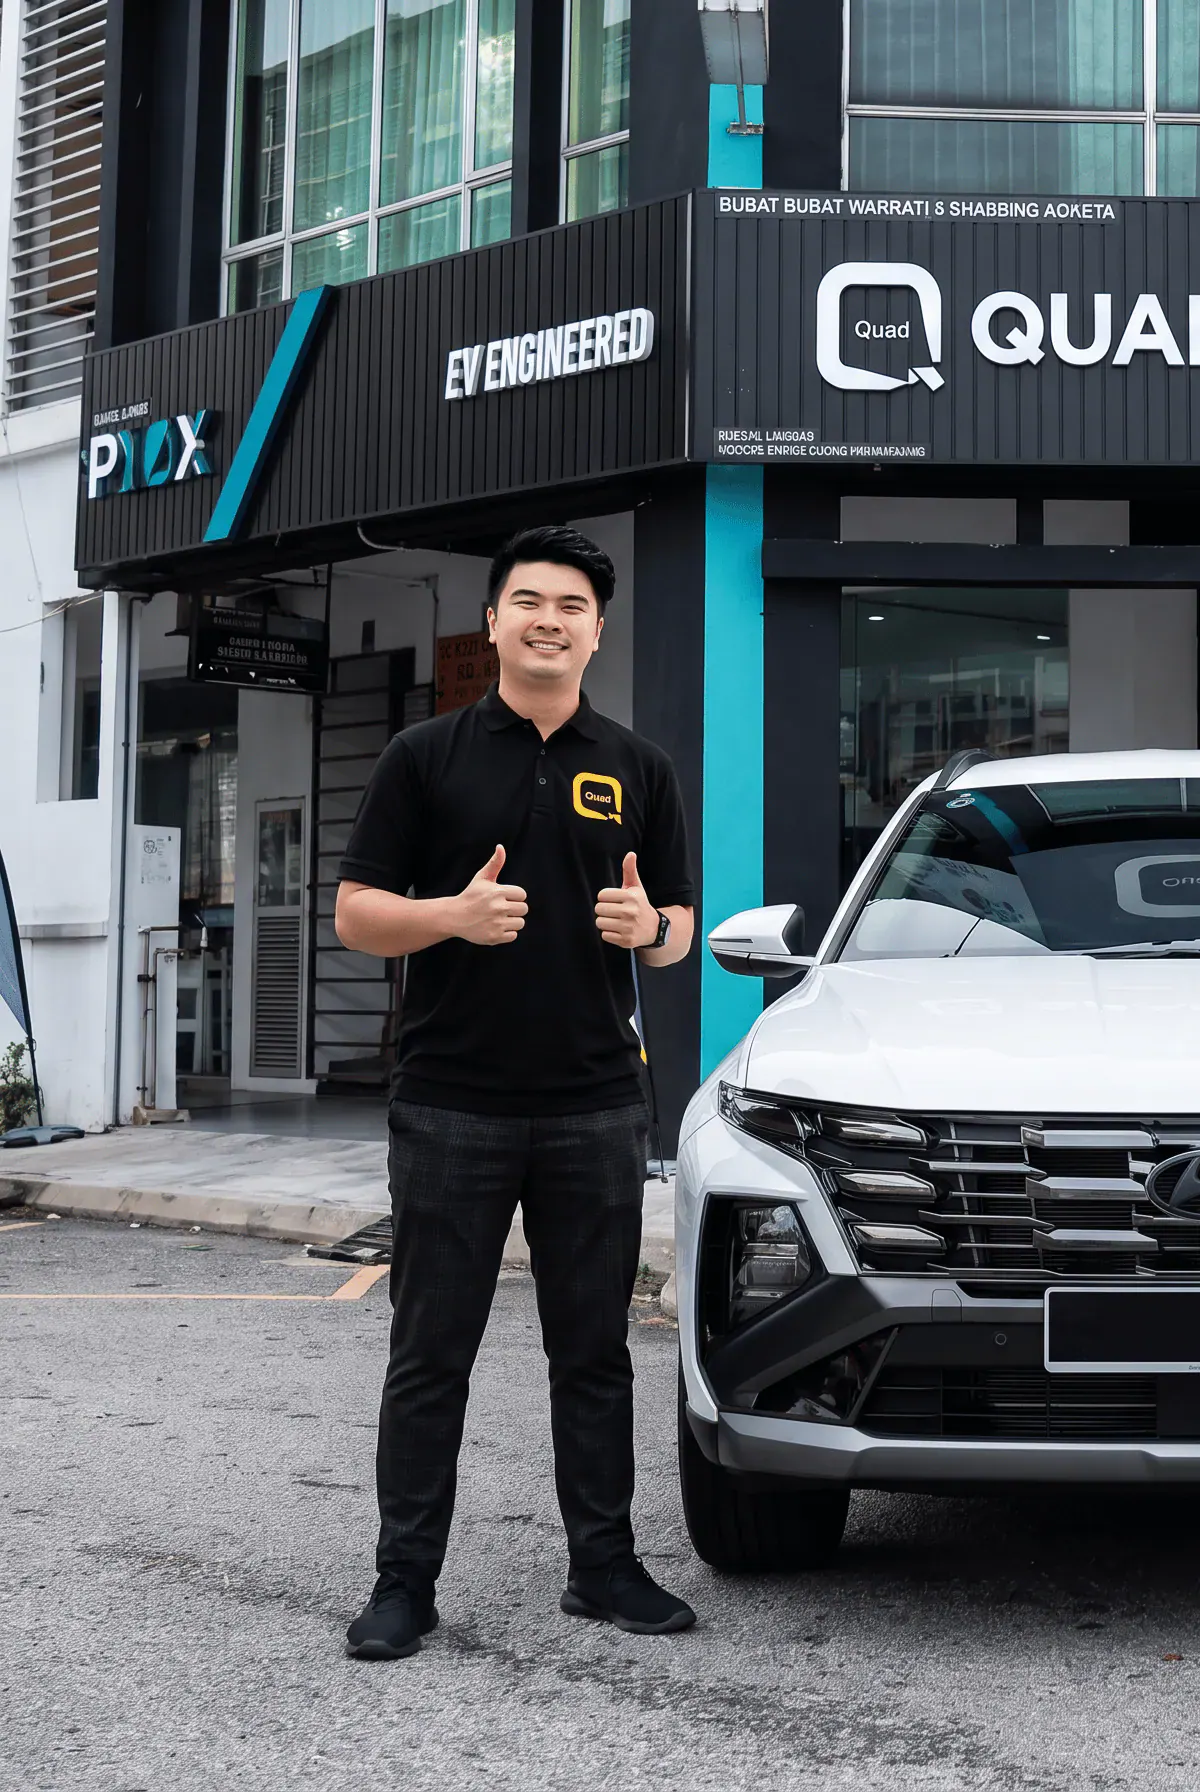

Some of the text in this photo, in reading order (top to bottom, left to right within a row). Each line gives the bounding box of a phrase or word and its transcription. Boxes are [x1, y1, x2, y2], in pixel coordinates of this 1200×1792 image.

[719, 196, 779, 213] BUBAT
[784, 197, 844, 214] BUBAT
[949, 202, 1039, 218] SHABBING
[855, 320, 910, 340] Quad
[445, 307, 655, 400] EV ENGINEERED
